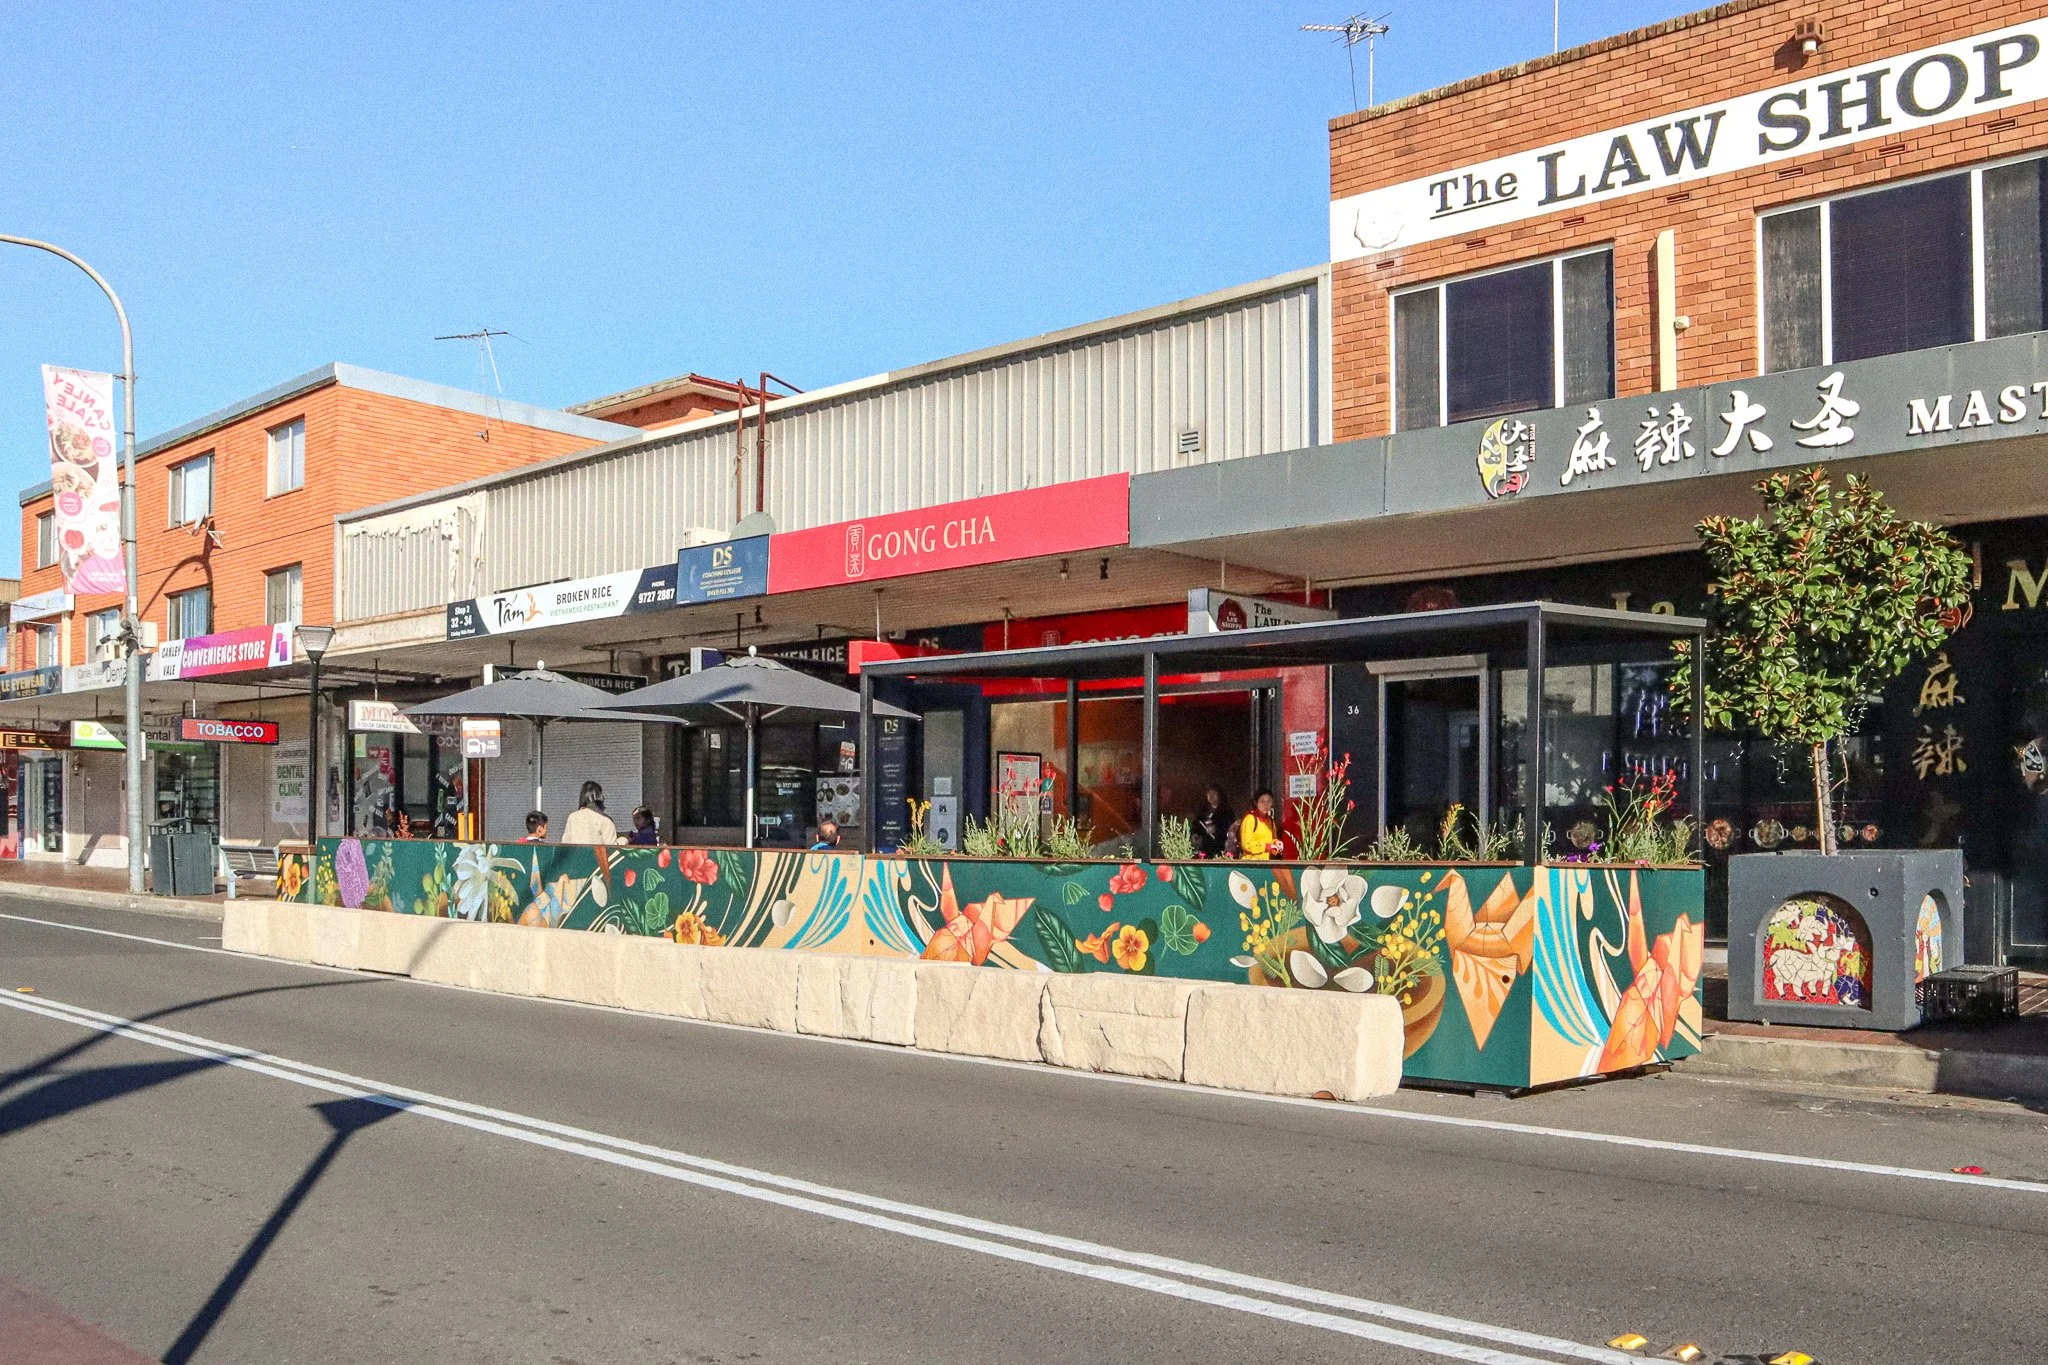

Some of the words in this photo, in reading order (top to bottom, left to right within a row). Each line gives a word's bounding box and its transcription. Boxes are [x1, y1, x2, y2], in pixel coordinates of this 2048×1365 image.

[1429, 171, 1519, 214] The
[1537, 110, 1727, 208] LAW
[1757, 33, 2041, 156] SHOP
[1560, 371, 1861, 487] 麻辣大圣
[867, 524, 936, 561] GONG
[943, 514, 996, 549] CHA
[713, 545, 733, 567] DS
[556, 588, 590, 605] BROKEN
[592, 585, 612, 599] RICE
[638, 590, 655, 604] 9727
[494, 594, 525, 628] Tấm
[549, 606, 583, 617] VIETNAMESE
[584, 600, 619, 613] RESTAURANT
[1253, 602, 1272, 616] The
[450, 617, 459, 628] 32
[464, 614, 472, 627] 34
[1254, 615, 1281, 629] LAW
[162, 645, 181, 659] CANLEY
[182, 645, 237, 668] CONVENIENCE
[238, 640, 265, 661] STORE
[811, 646, 844, 663] RICE
[106, 665, 127, 683] Denta
[163, 664, 175, 676] VALE
[614, 680, 636, 690] RICE
[1347, 705, 1360, 715] 36
[196, 722, 264, 738] TOBACCO
[884, 719, 899, 733] DS
[146, 730, 171, 740] ental
[277, 765, 304, 779] DENTAL
